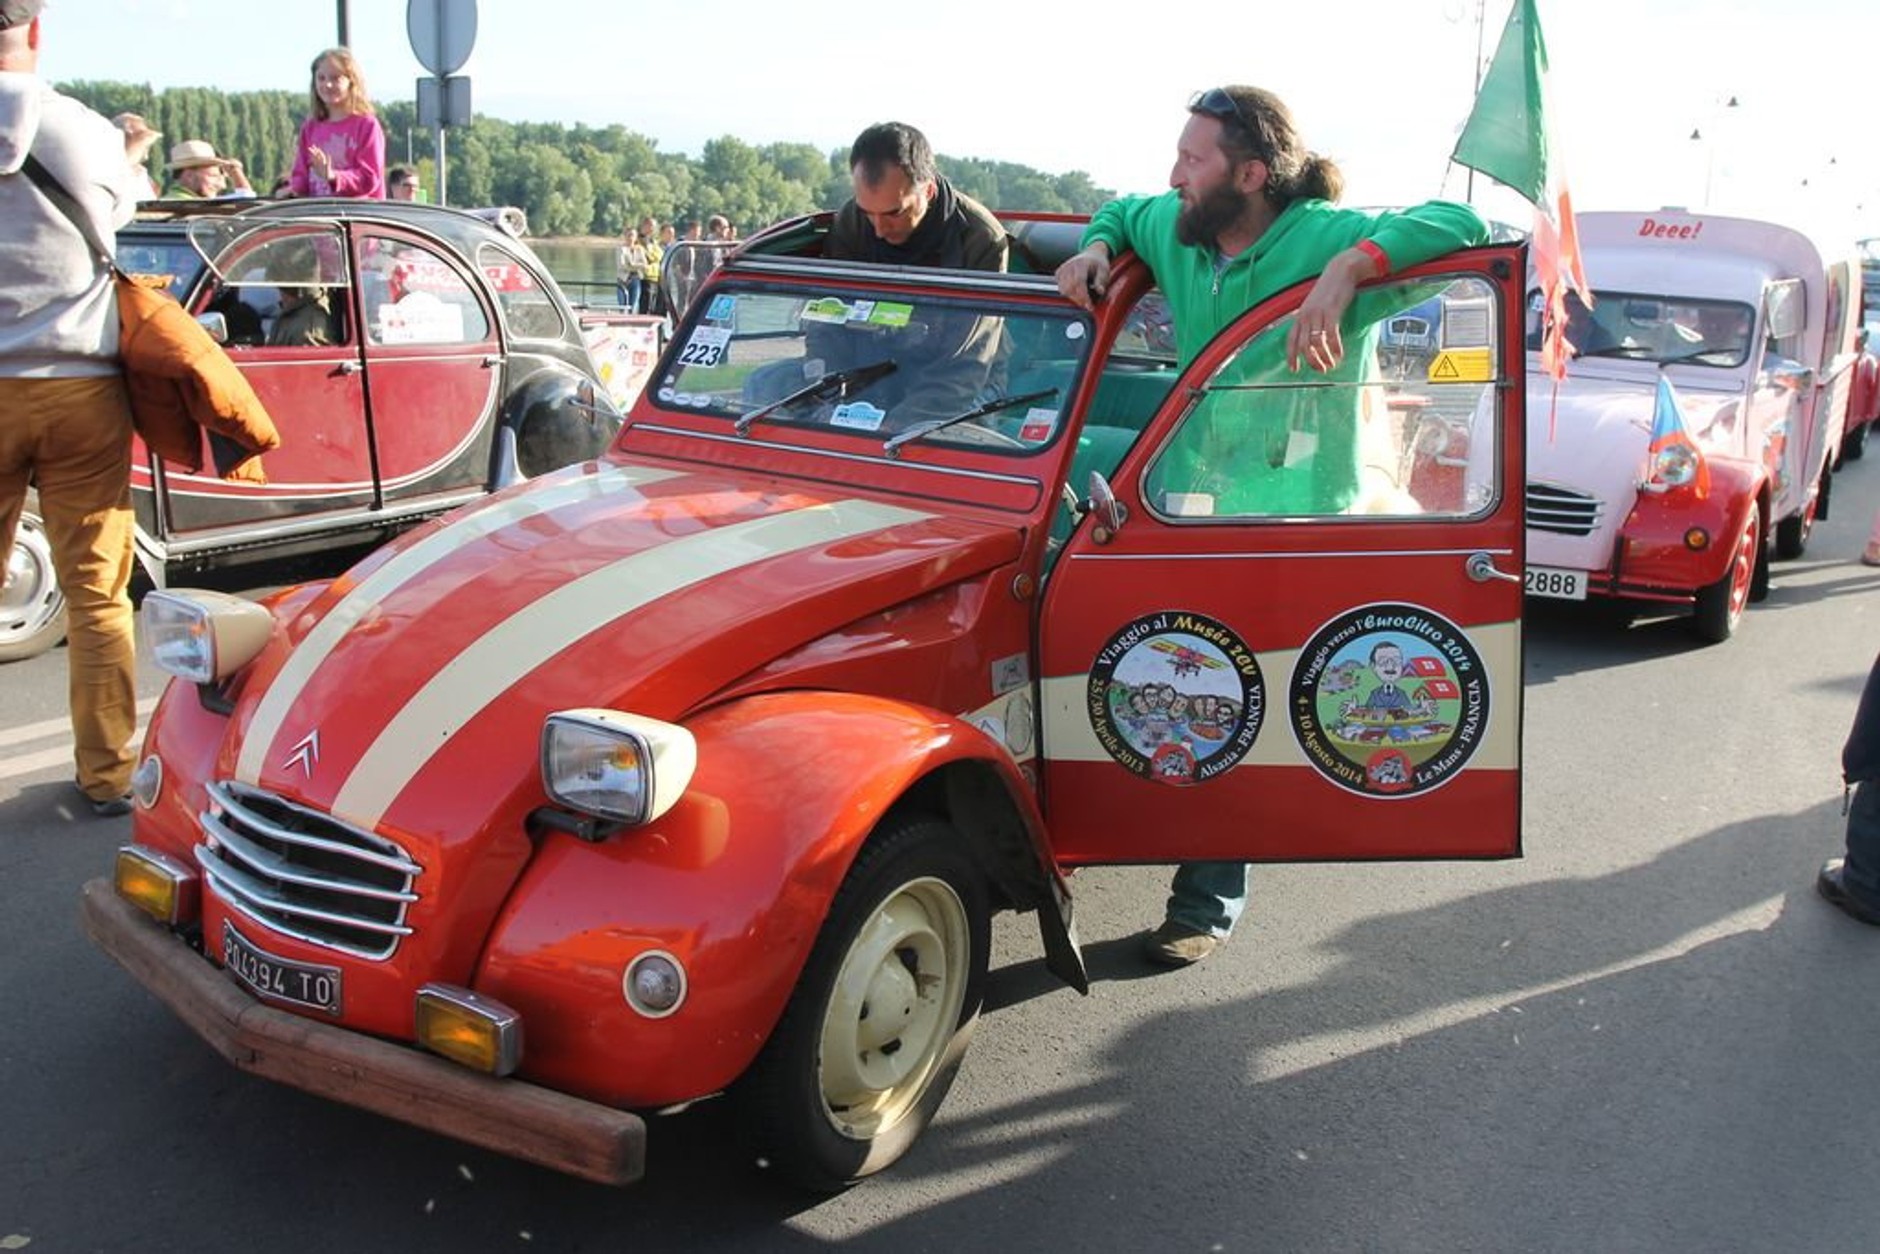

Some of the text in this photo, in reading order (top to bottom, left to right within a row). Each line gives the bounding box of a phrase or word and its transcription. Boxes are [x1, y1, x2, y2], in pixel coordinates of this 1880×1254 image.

[1639, 218, 1703, 239] Deee!
[681, 343, 721, 367] 223
[1525, 571, 1576, 595] 2888
[1098, 614, 1258, 677] Viaggio al Musée 2CV
[1301, 645, 1330, 686] Viaggio
[1327, 626, 1356, 648] verso
[1441, 638, 1472, 672] 2014
[1200, 750, 1239, 779] Alsazia
[1237, 684, 1262, 748] FRANCIA
[1299, 713, 1313, 730] 10
[1416, 770, 1435, 784] Le
[1431, 747, 1463, 776] Mans
[1459, 678, 1482, 744] FRANCIA
[1095, 718, 1118, 752] Aprile
[1116, 749, 1145, 773] 2013
[1303, 731, 1335, 767] Agosto
[1332, 761, 1364, 785] 2014
[300, 973, 331, 1005] TO
